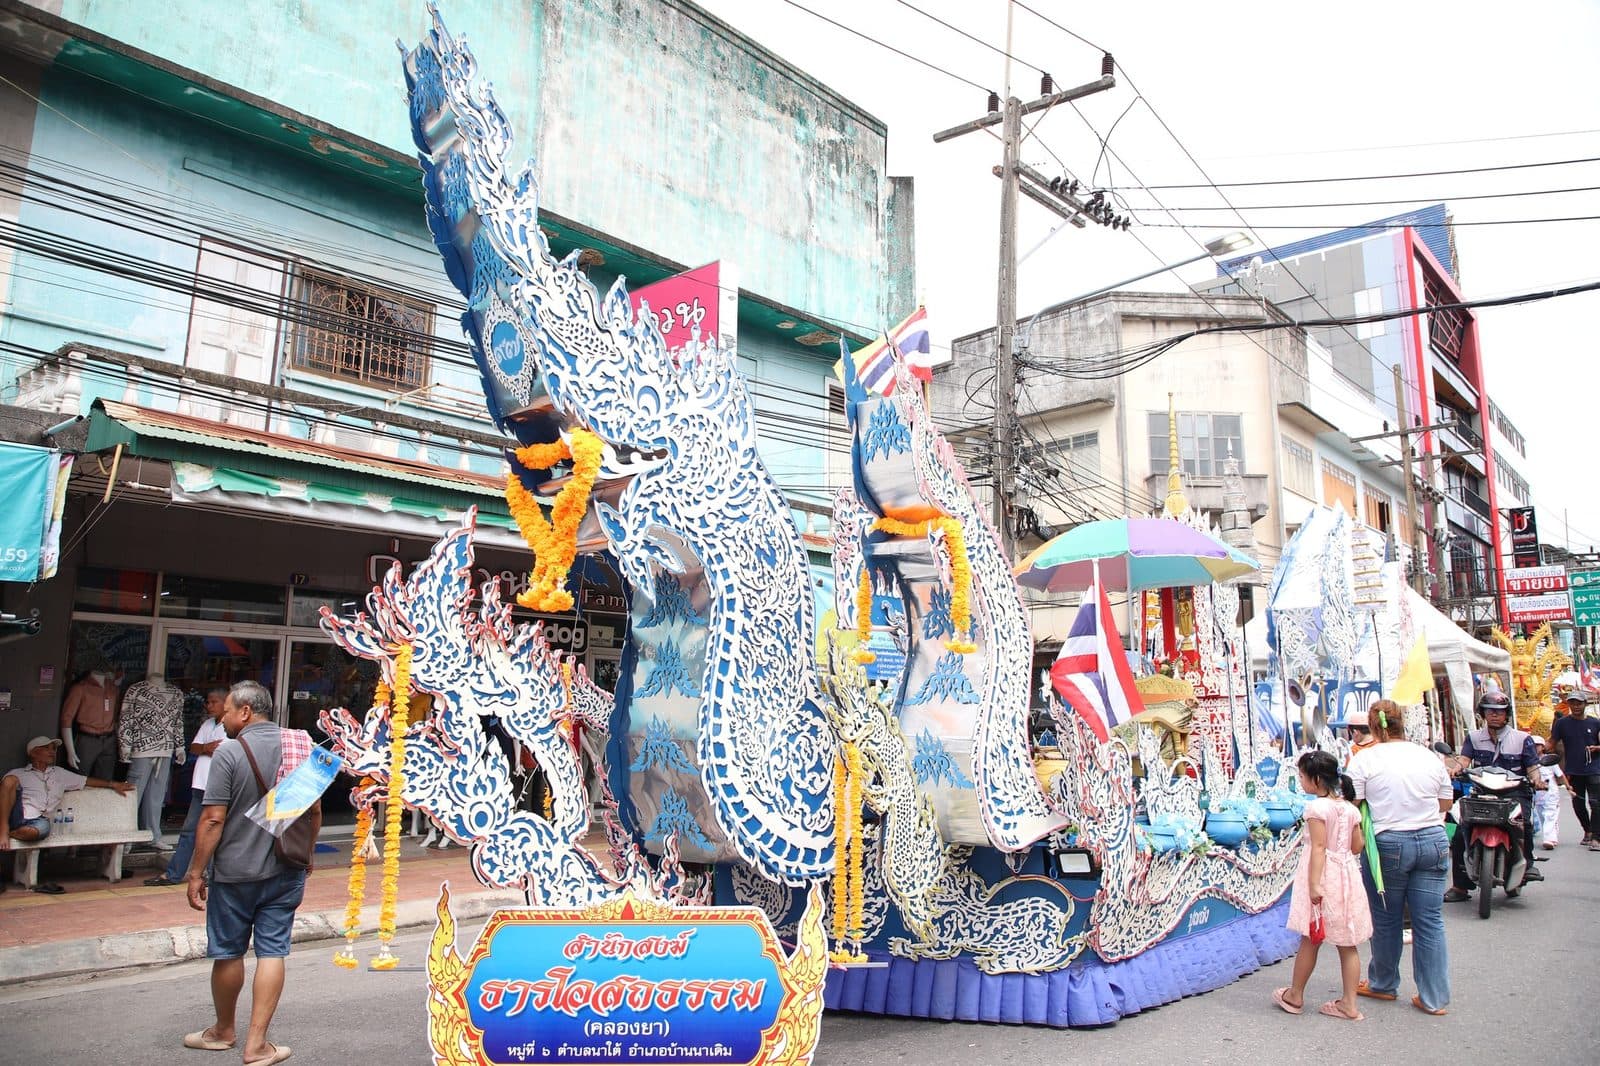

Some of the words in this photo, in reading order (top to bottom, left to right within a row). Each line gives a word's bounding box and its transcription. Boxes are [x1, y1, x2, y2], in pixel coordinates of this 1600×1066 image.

[295, 574, 305, 585] 17
[1509, 577, 1565, 591] ขายยา
[563, 928, 697, 961] สำนักสงฆ์
[584, 1019, 670, 1037] (คลองยา)
[507, 1040, 535, 1061] หมู่ที่
[542, 1048, 550, 1056] ๖
[558, 1041, 621, 1057] ตำบลนาใต้
[629, 1042, 732, 1058] อำเภอบ้านนาเดิม
